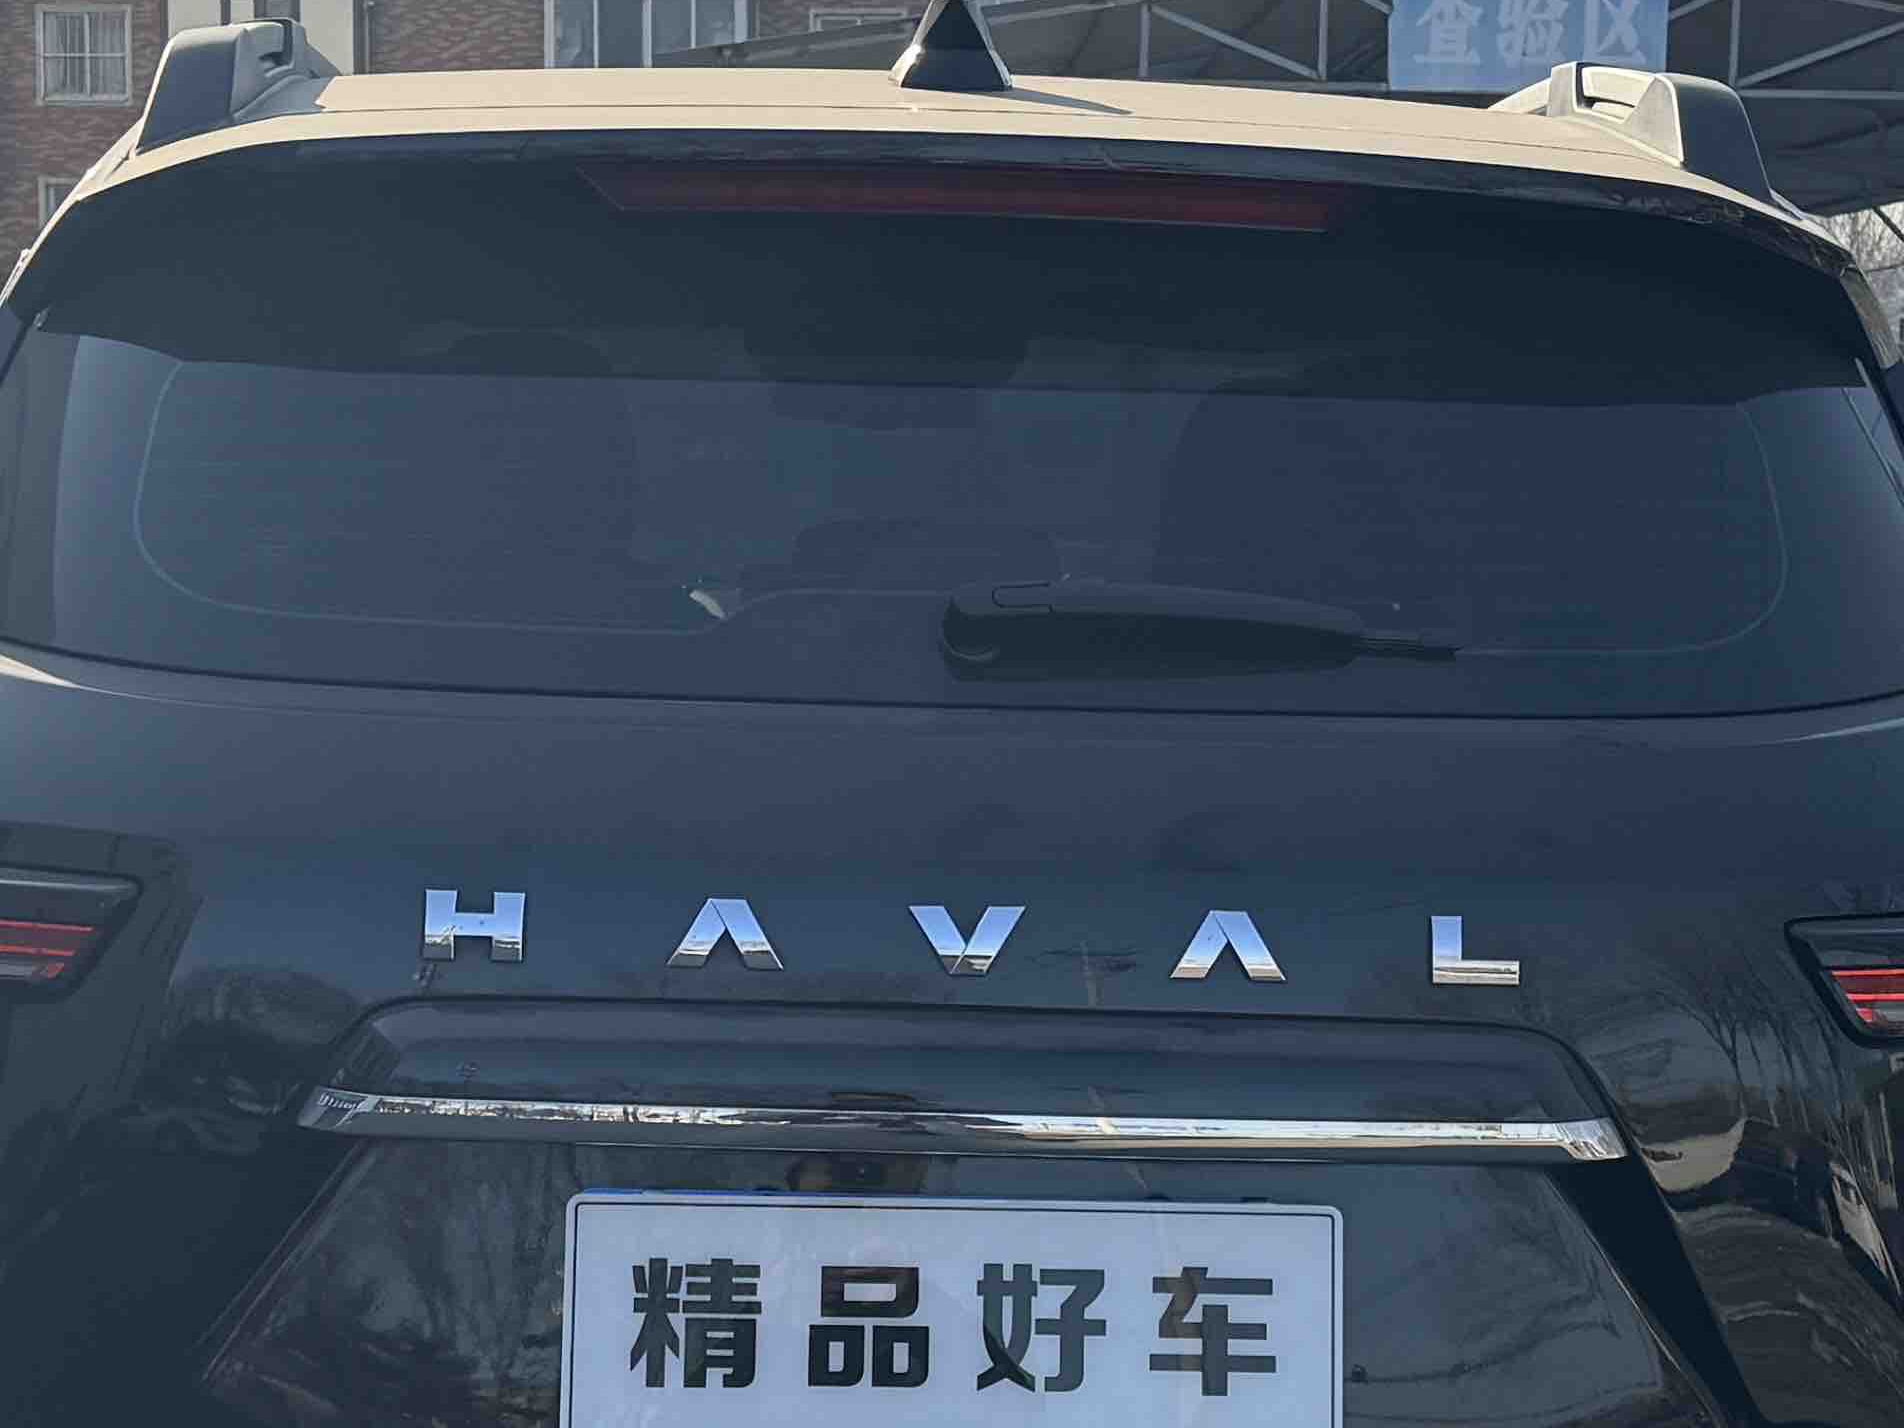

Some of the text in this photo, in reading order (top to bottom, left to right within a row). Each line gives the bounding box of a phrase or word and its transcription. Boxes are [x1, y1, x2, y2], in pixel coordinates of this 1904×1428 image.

[422, 888, 1522, 985] HAVAL
[627, 1256, 1278, 1398] 精品好车
